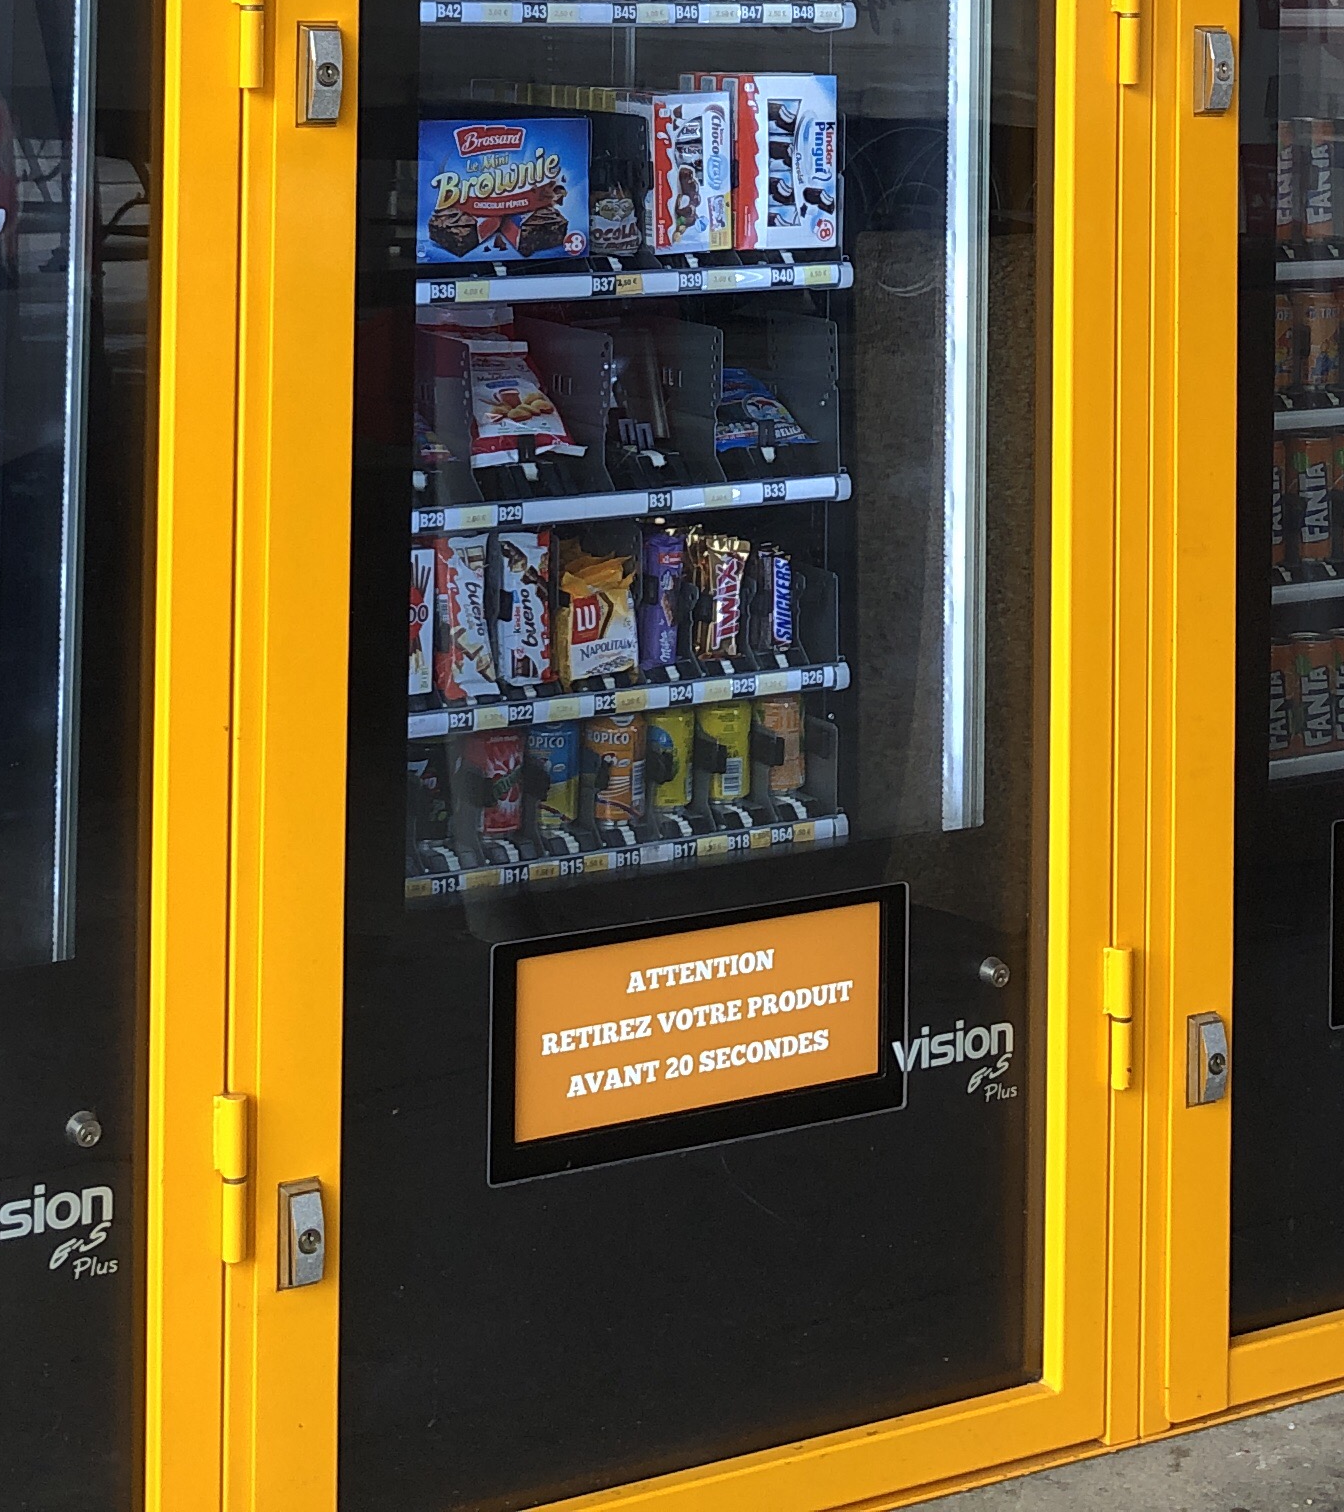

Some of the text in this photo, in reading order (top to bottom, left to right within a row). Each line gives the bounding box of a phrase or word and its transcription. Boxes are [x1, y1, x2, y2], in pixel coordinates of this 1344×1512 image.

[438, 3, 462, 18] B42
[523, 3, 547, 18] B43
[614, 4, 636, 19] B45
[676, 5, 698, 19] B46
[741, 5, 762, 19] B47
[793, 5, 814, 19] B48
[461, 131, 522, 152] Brossard
[431, 148, 561, 211] Brownie
[680, 273, 702, 287] B39
[772, 268, 794, 282] B40
[431, 284, 455, 299] B36
[593, 277, 616, 292] B37
[764, 482, 786, 498] B33
[650, 493, 672, 508] B31
[1299, 461, 1330, 544] FANTA
[419, 510, 444, 528] B28
[498, 504, 522, 521] B29
[711, 555, 742, 651] TWIX
[774, 556, 793, 645] SNICKERS
[464, 581, 486, 637] bueno
[521, 588, 539, 648] bueno
[575, 604, 598, 632] LU
[733, 678, 755, 693] B25
[802, 670, 823, 685] B26
[595, 695, 616, 710] B23
[670, 687, 692, 702] B24
[509, 705, 533, 720] B22
[1300, 665, 1332, 748] FANTA
[449, 713, 473, 728] B21
[728, 834, 750, 850] B18
[771, 827, 793, 842] B64
[674, 842, 697, 858] B17
[560, 859, 584, 875] B15
[616, 851, 640, 867] B16
[506, 866, 529, 883] B14
[431, 878, 455, 894] B13
[626, 949, 775, 994] ATTENTION
[541, 980, 853, 1056] RETIREZ VOTRE PRODUIT
[892, 1019, 1014, 1072] vision
[567, 1029, 829, 1098] AVANT 20 SECONDES
[984, 1082, 1018, 1103] Plus
[72, 1255, 119, 1280] Plus
